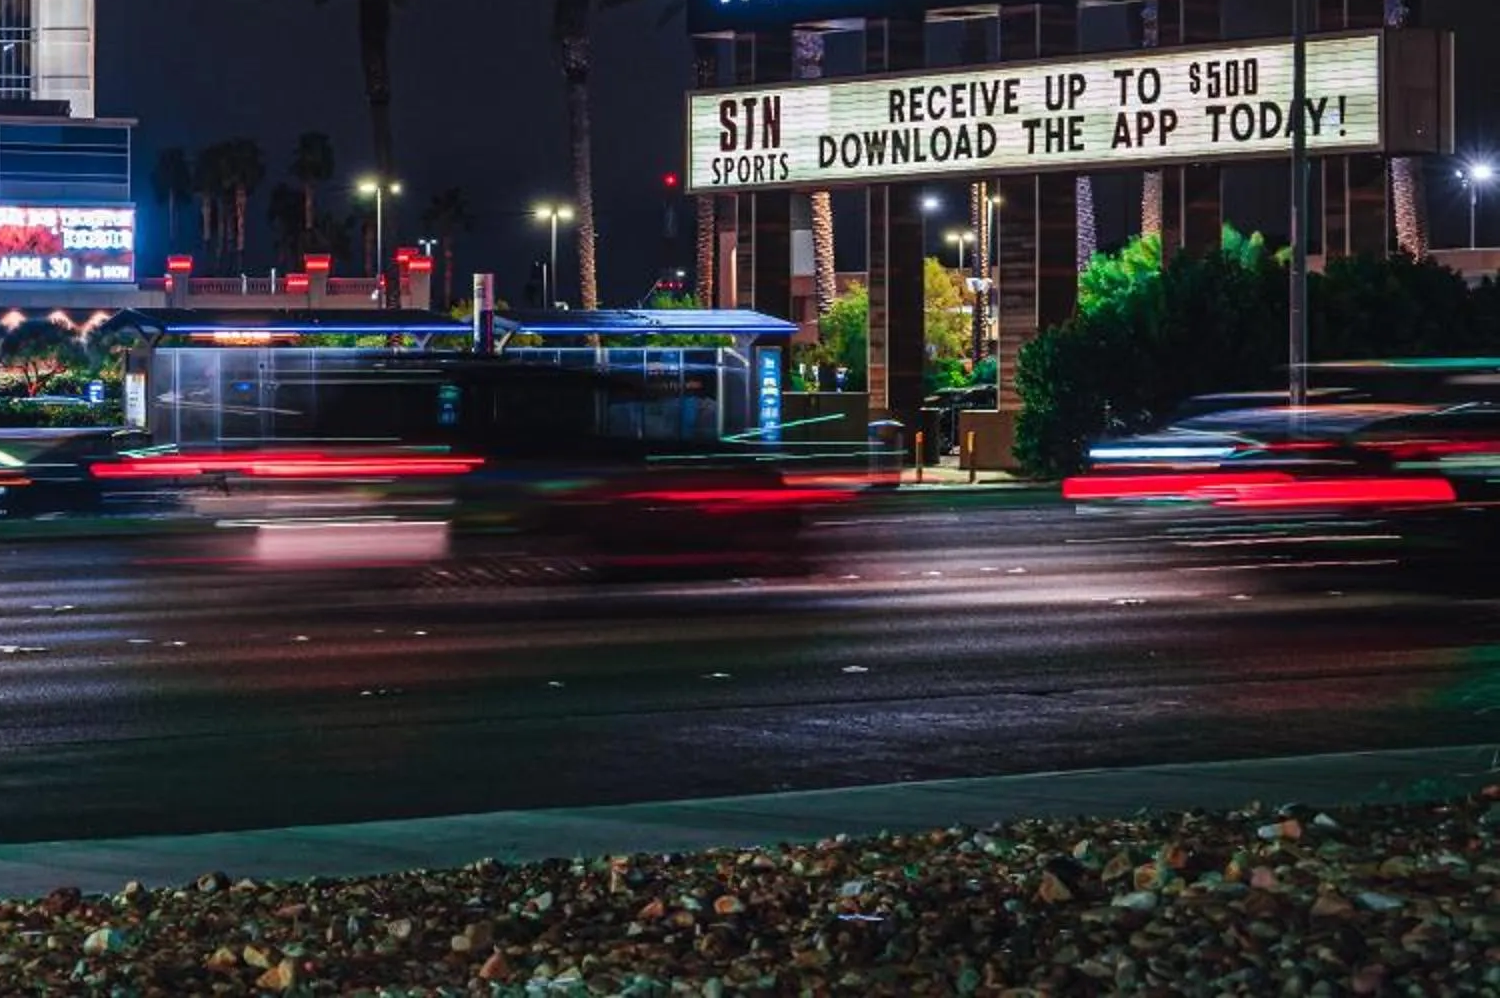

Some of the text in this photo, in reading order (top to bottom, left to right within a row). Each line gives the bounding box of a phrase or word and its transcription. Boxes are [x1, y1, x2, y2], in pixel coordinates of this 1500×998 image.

[888, 57, 1258, 124] RECEIVE UP TO $500
[719, 95, 782, 152] STN
[818, 122, 998, 169] DOWNLOAD
[1022, 115, 1086, 154] THE
[1111, 108, 1179, 150] APP
[711, 153, 789, 185] SPORTS
